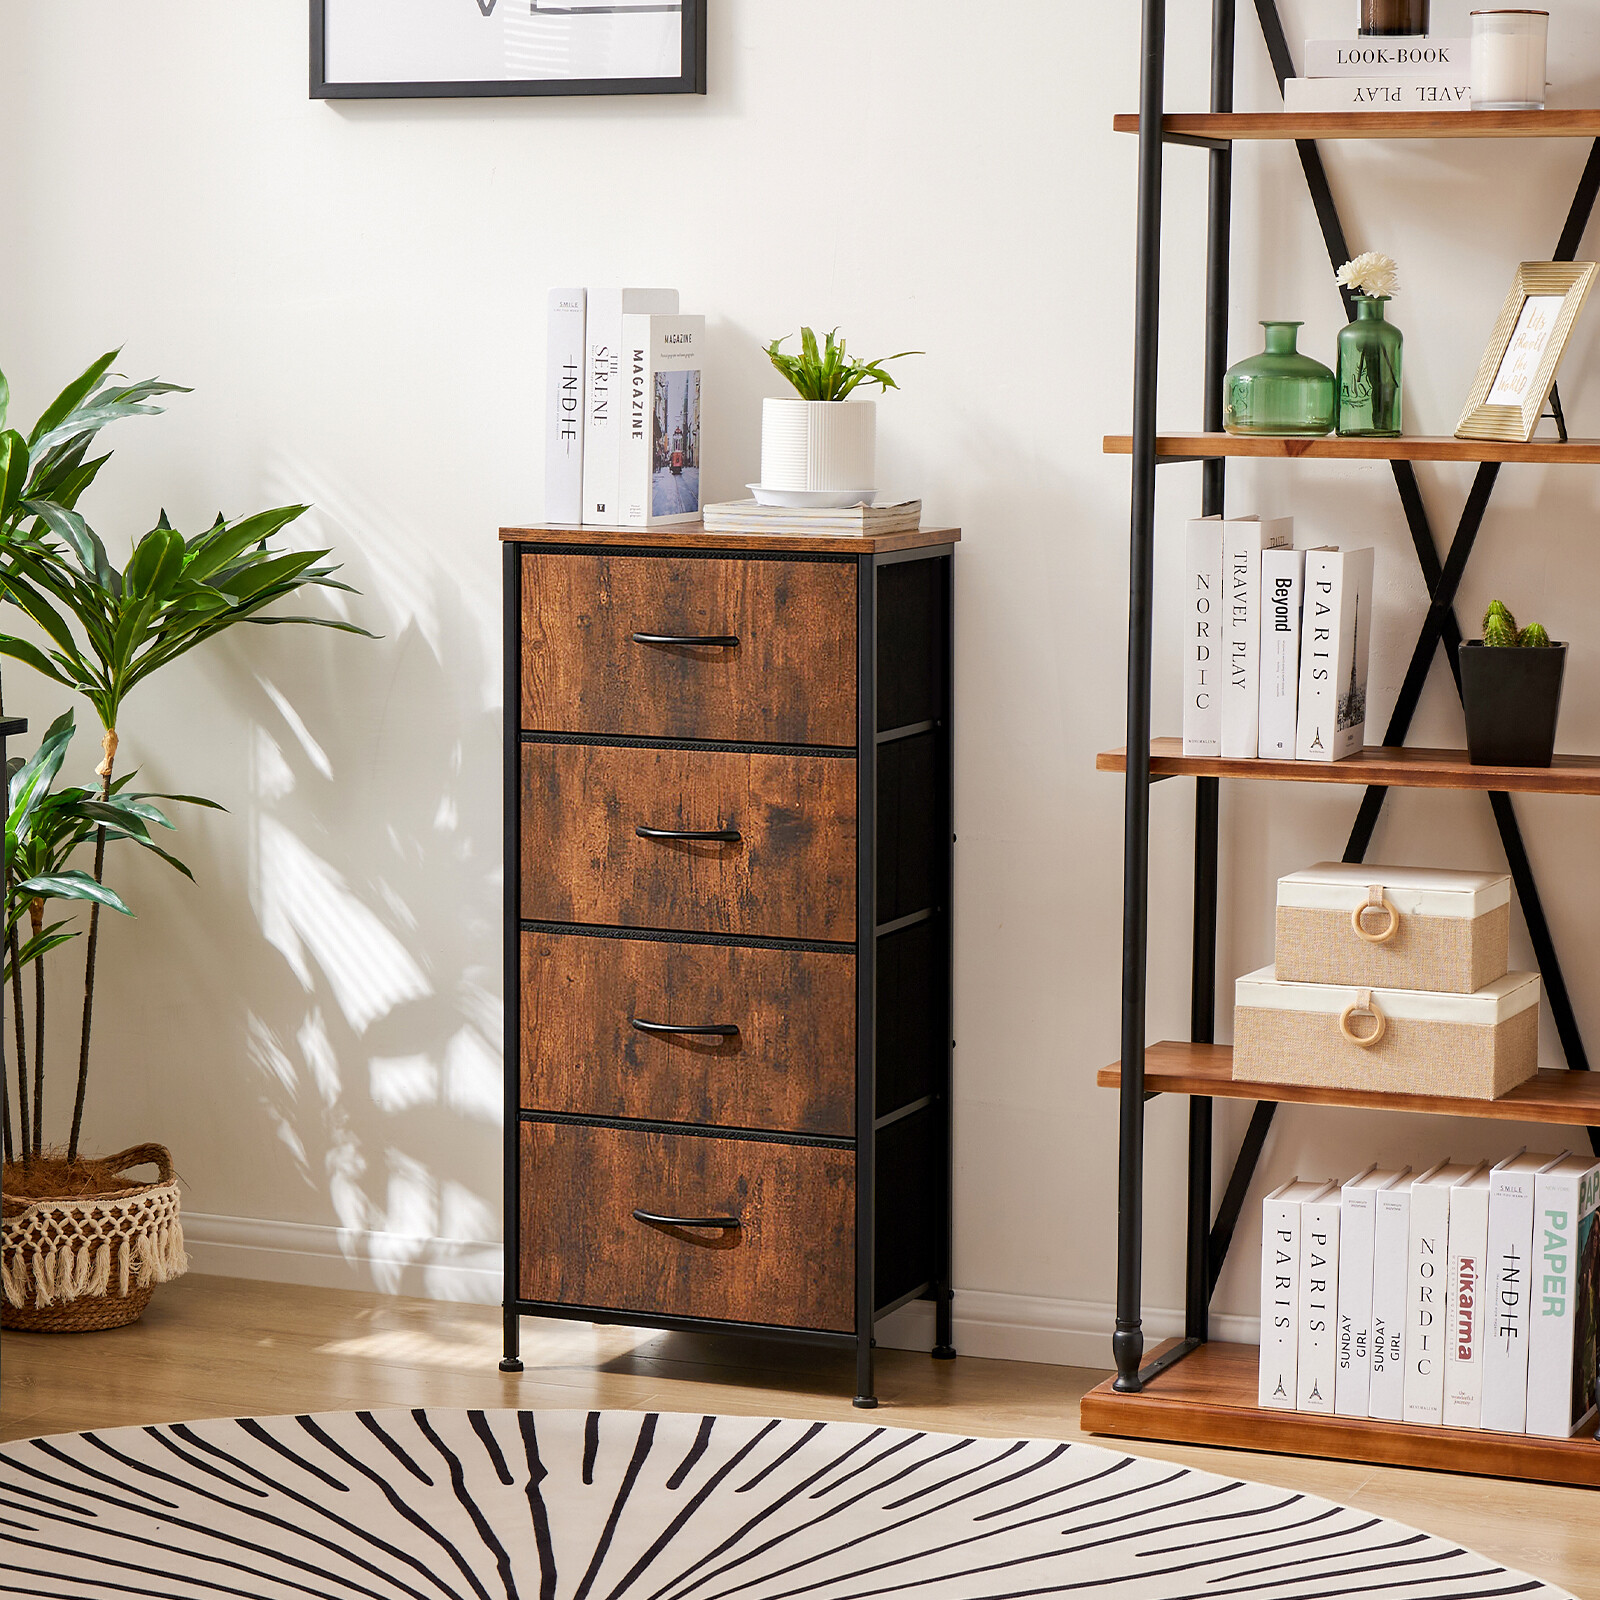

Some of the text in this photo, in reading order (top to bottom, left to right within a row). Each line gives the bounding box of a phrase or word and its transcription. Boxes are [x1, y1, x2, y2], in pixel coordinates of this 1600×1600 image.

[1337, 48, 1450, 64] LOOK-BOOK
[1353, 86, 1471, 102] AVEL PLAY
[610, 353, 618, 377] THE
[664, 333, 692, 344] MAGAZINE
[561, 365, 578, 440] INDIE
[594, 344, 609, 428] SERENE
[632, 350, 644, 440] MAGAZINE
[1232, 550, 1248, 690] TRAVEL PLAY
[1271, 578, 1293, 632] Beyond
[1312, 581, 1332, 680] PARIS
[1196, 574, 1211, 709] NORDIC
[1500, 1184, 1522, 1193] SMILE
[1578, 1170, 1600, 1215] PAP
[1275, 1229, 1292, 1328] PARIS
[1310, 1233, 1326, 1331] PARIS
[1542, 1210, 1568, 1317] PAPER
[1417, 1237, 1436, 1375] NORDIC
[1500, 1255, 1520, 1338] INDIE
[1341, 1314, 1351, 1369] SUNDAY
[1356, 1329, 1367, 1357] GIRL
[1374, 1317, 1385, 1372] SUNDAY
[1390, 1332, 1401, 1361] GIRL
